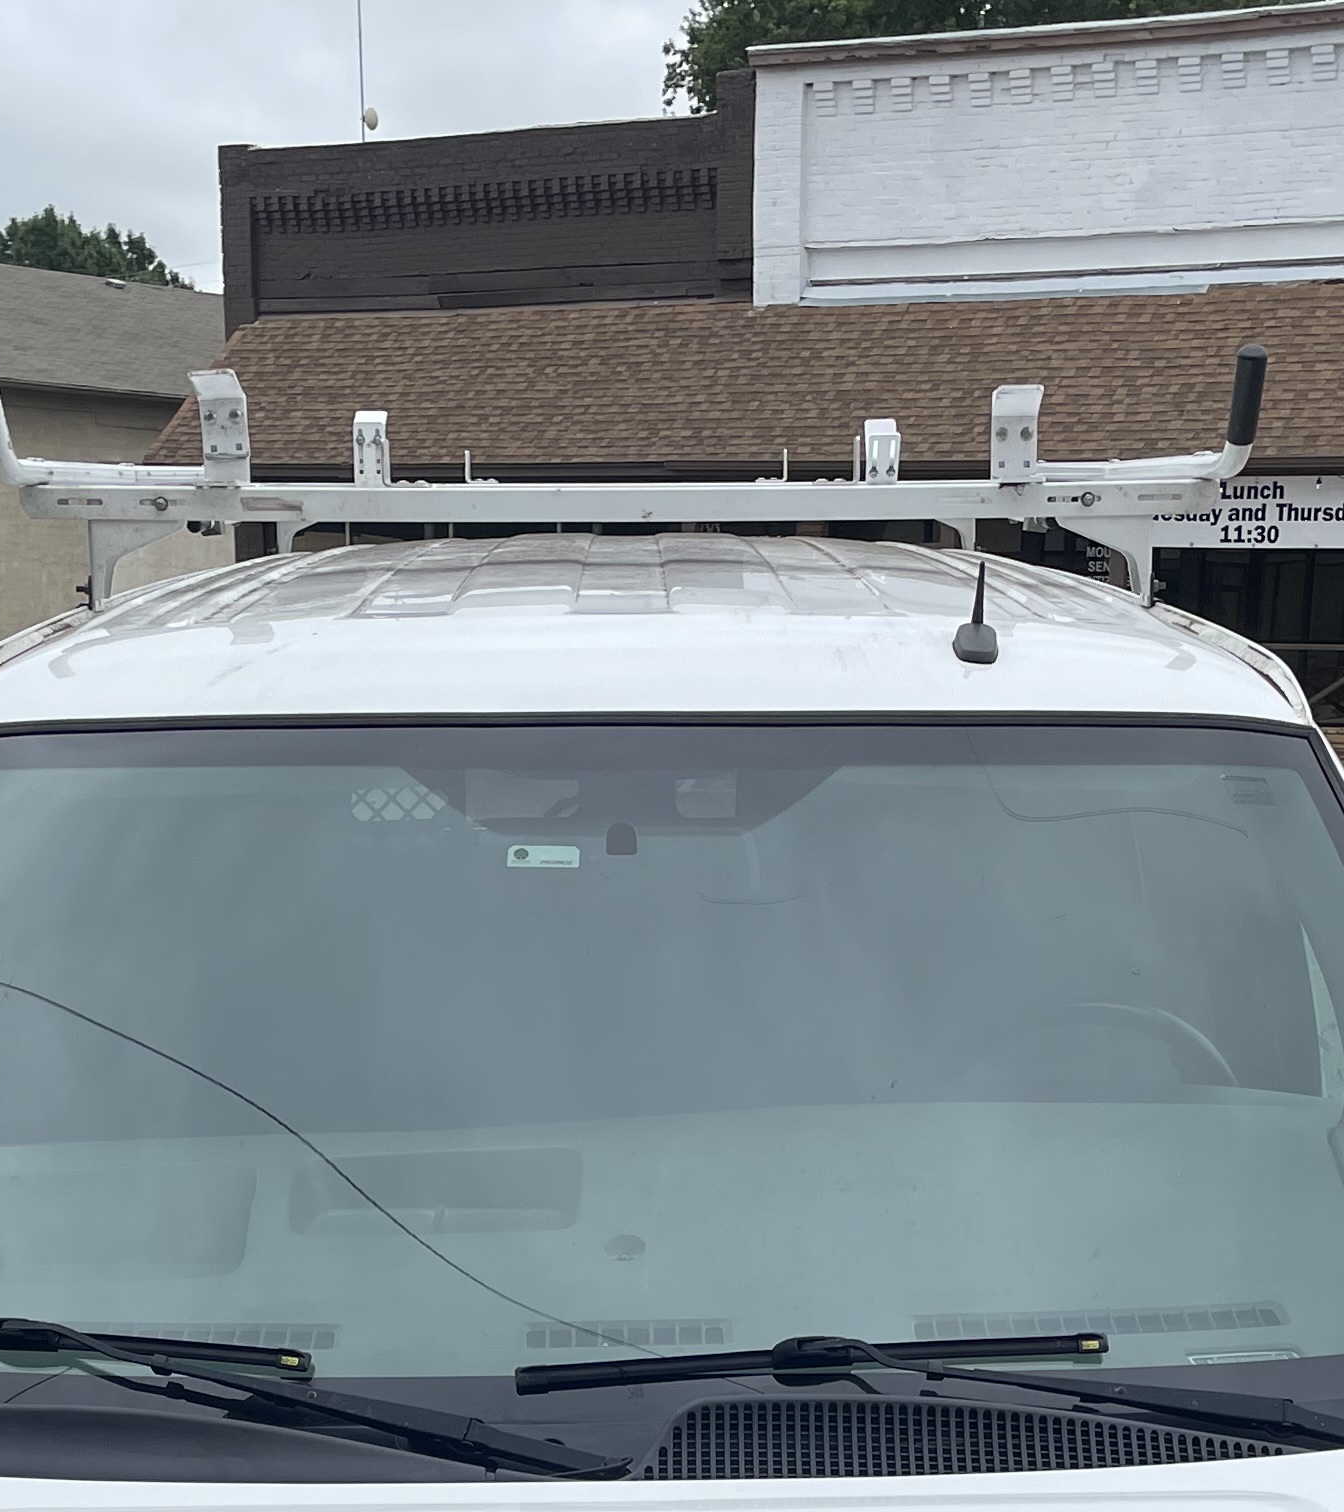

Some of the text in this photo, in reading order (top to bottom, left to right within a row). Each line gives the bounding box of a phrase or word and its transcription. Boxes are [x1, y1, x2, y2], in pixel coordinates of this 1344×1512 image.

[1220, 480, 1285, 500] Lunch
[1227, 503, 1267, 522] and
[1219, 525, 1280, 543] 11:30
